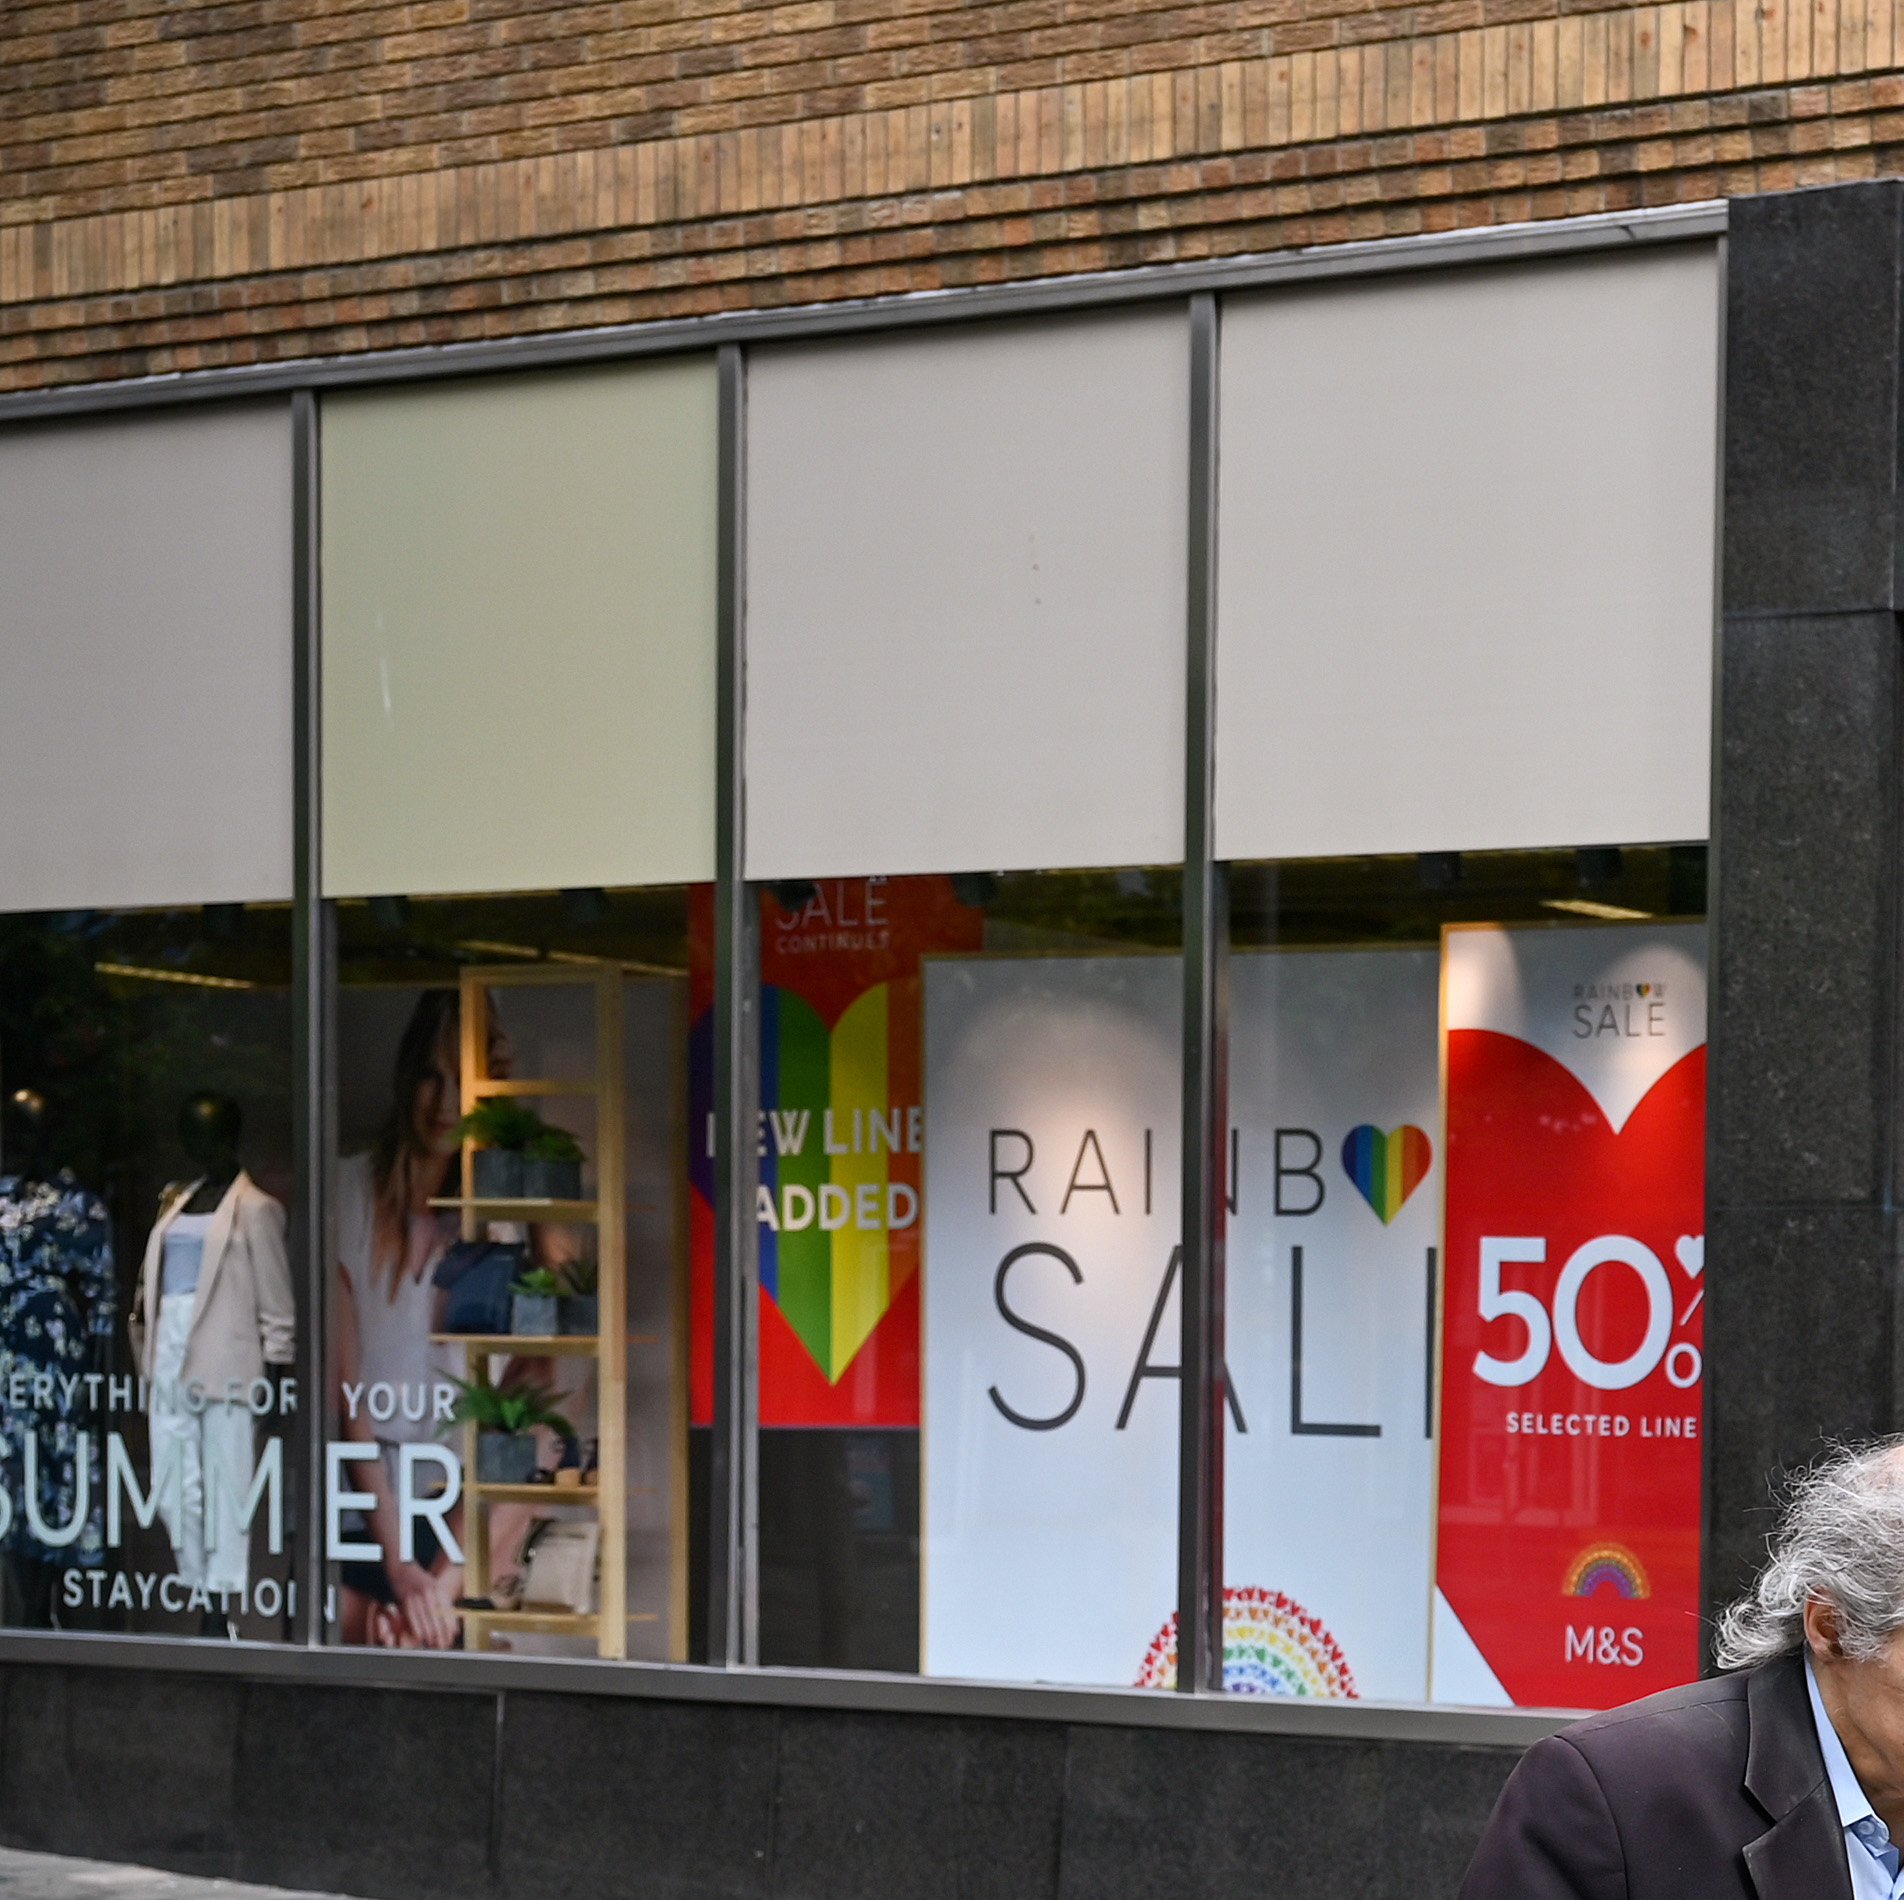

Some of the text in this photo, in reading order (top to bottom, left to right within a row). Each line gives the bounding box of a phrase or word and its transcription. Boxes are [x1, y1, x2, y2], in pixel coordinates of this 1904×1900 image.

[1572, 1001, 1666, 1039] SALE
[757, 1182, 919, 1231] ADDED
[0, 1372, 458, 1423] ERYTHING FOR YOUR
[1506, 1411, 1630, 1437] SELECTED
[1565, 1624, 1644, 1667] M&S
